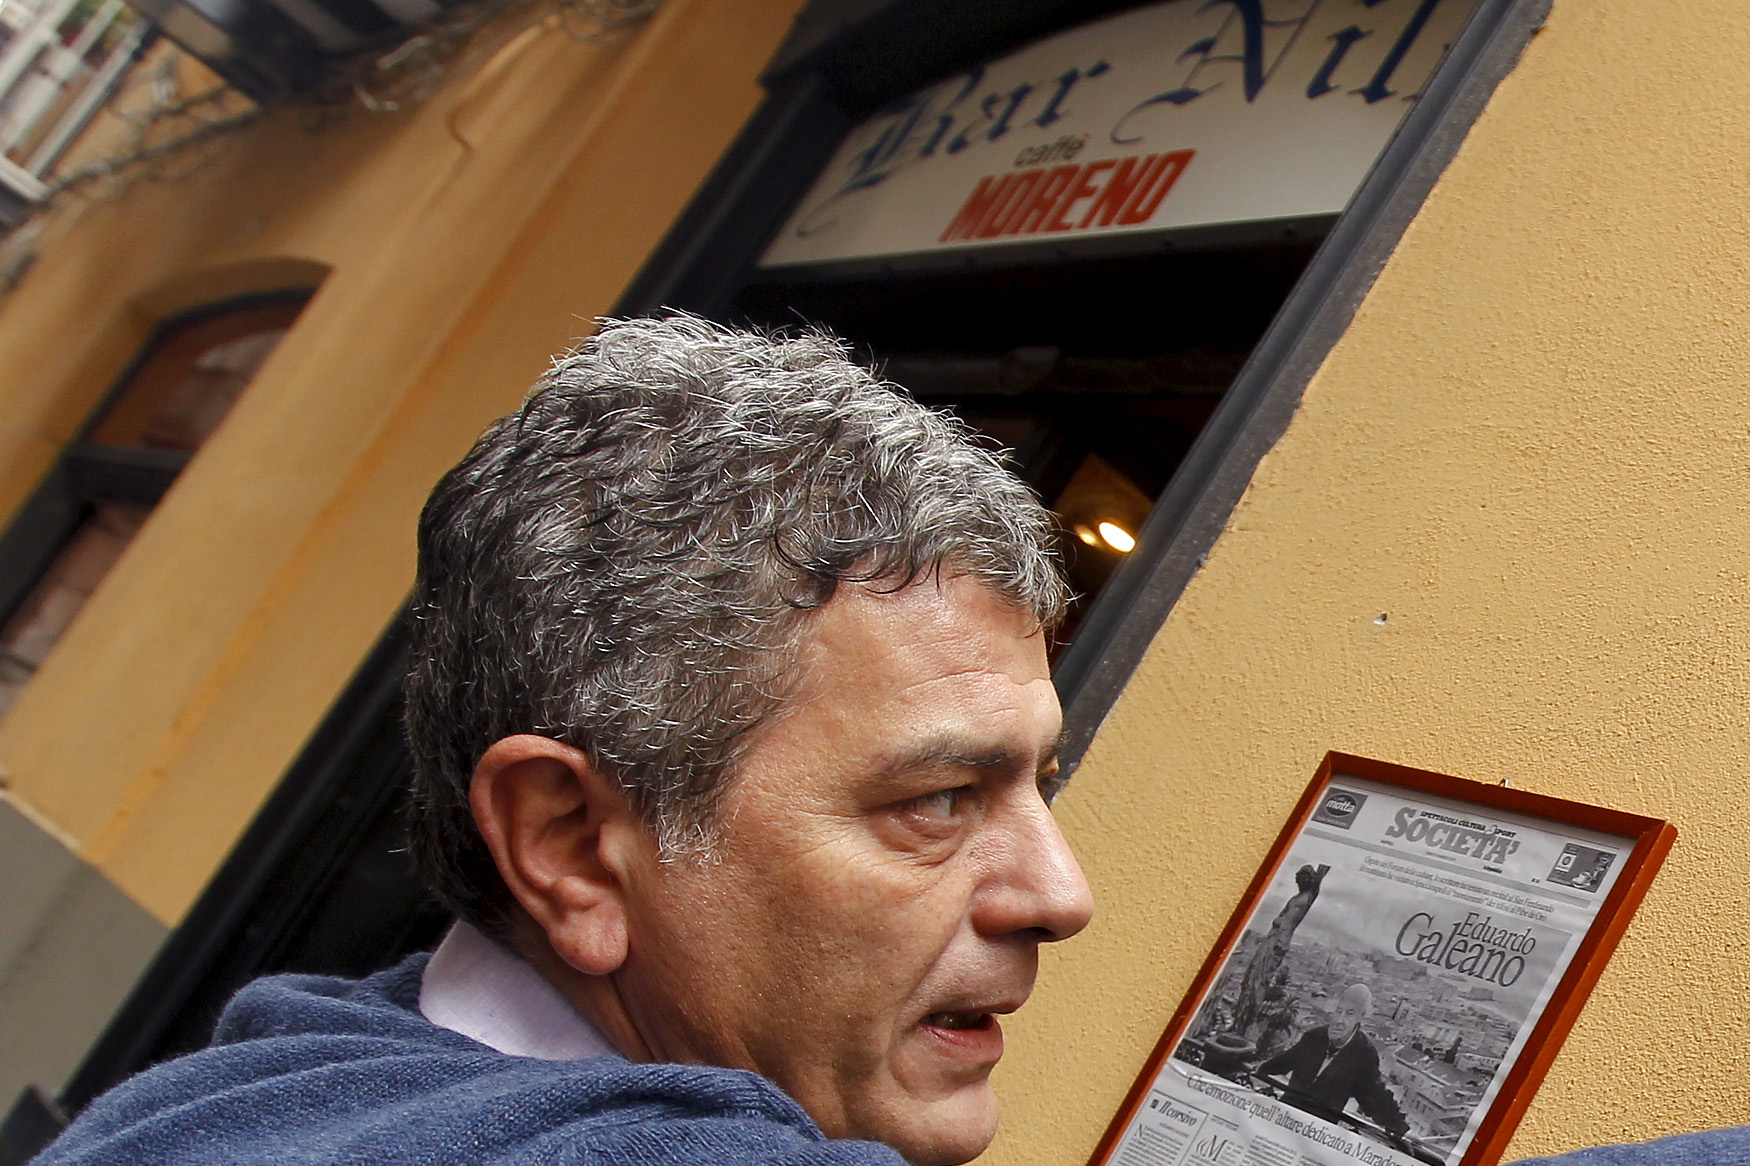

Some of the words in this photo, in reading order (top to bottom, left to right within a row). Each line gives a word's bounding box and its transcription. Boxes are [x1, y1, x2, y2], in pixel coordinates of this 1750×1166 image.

[1110, 0, 1452, 143] Nil
[1013, 134, 1092, 167] caffè
[938, 149, 1196, 243] MORENO
[1325, 799, 1356, 813] motta
[1420, 810, 1459, 826] SPETTACOLI
[1385, 806, 1521, 865] SOCIETA'
[1395, 912, 1526, 987] Galeano
[1457, 911, 1536, 955] Eduardo
[1167, 1104, 1197, 1127] corsivo
[1205, 1082, 1250, 1112] emozione
[1301, 1118, 1347, 1152] dedicato
